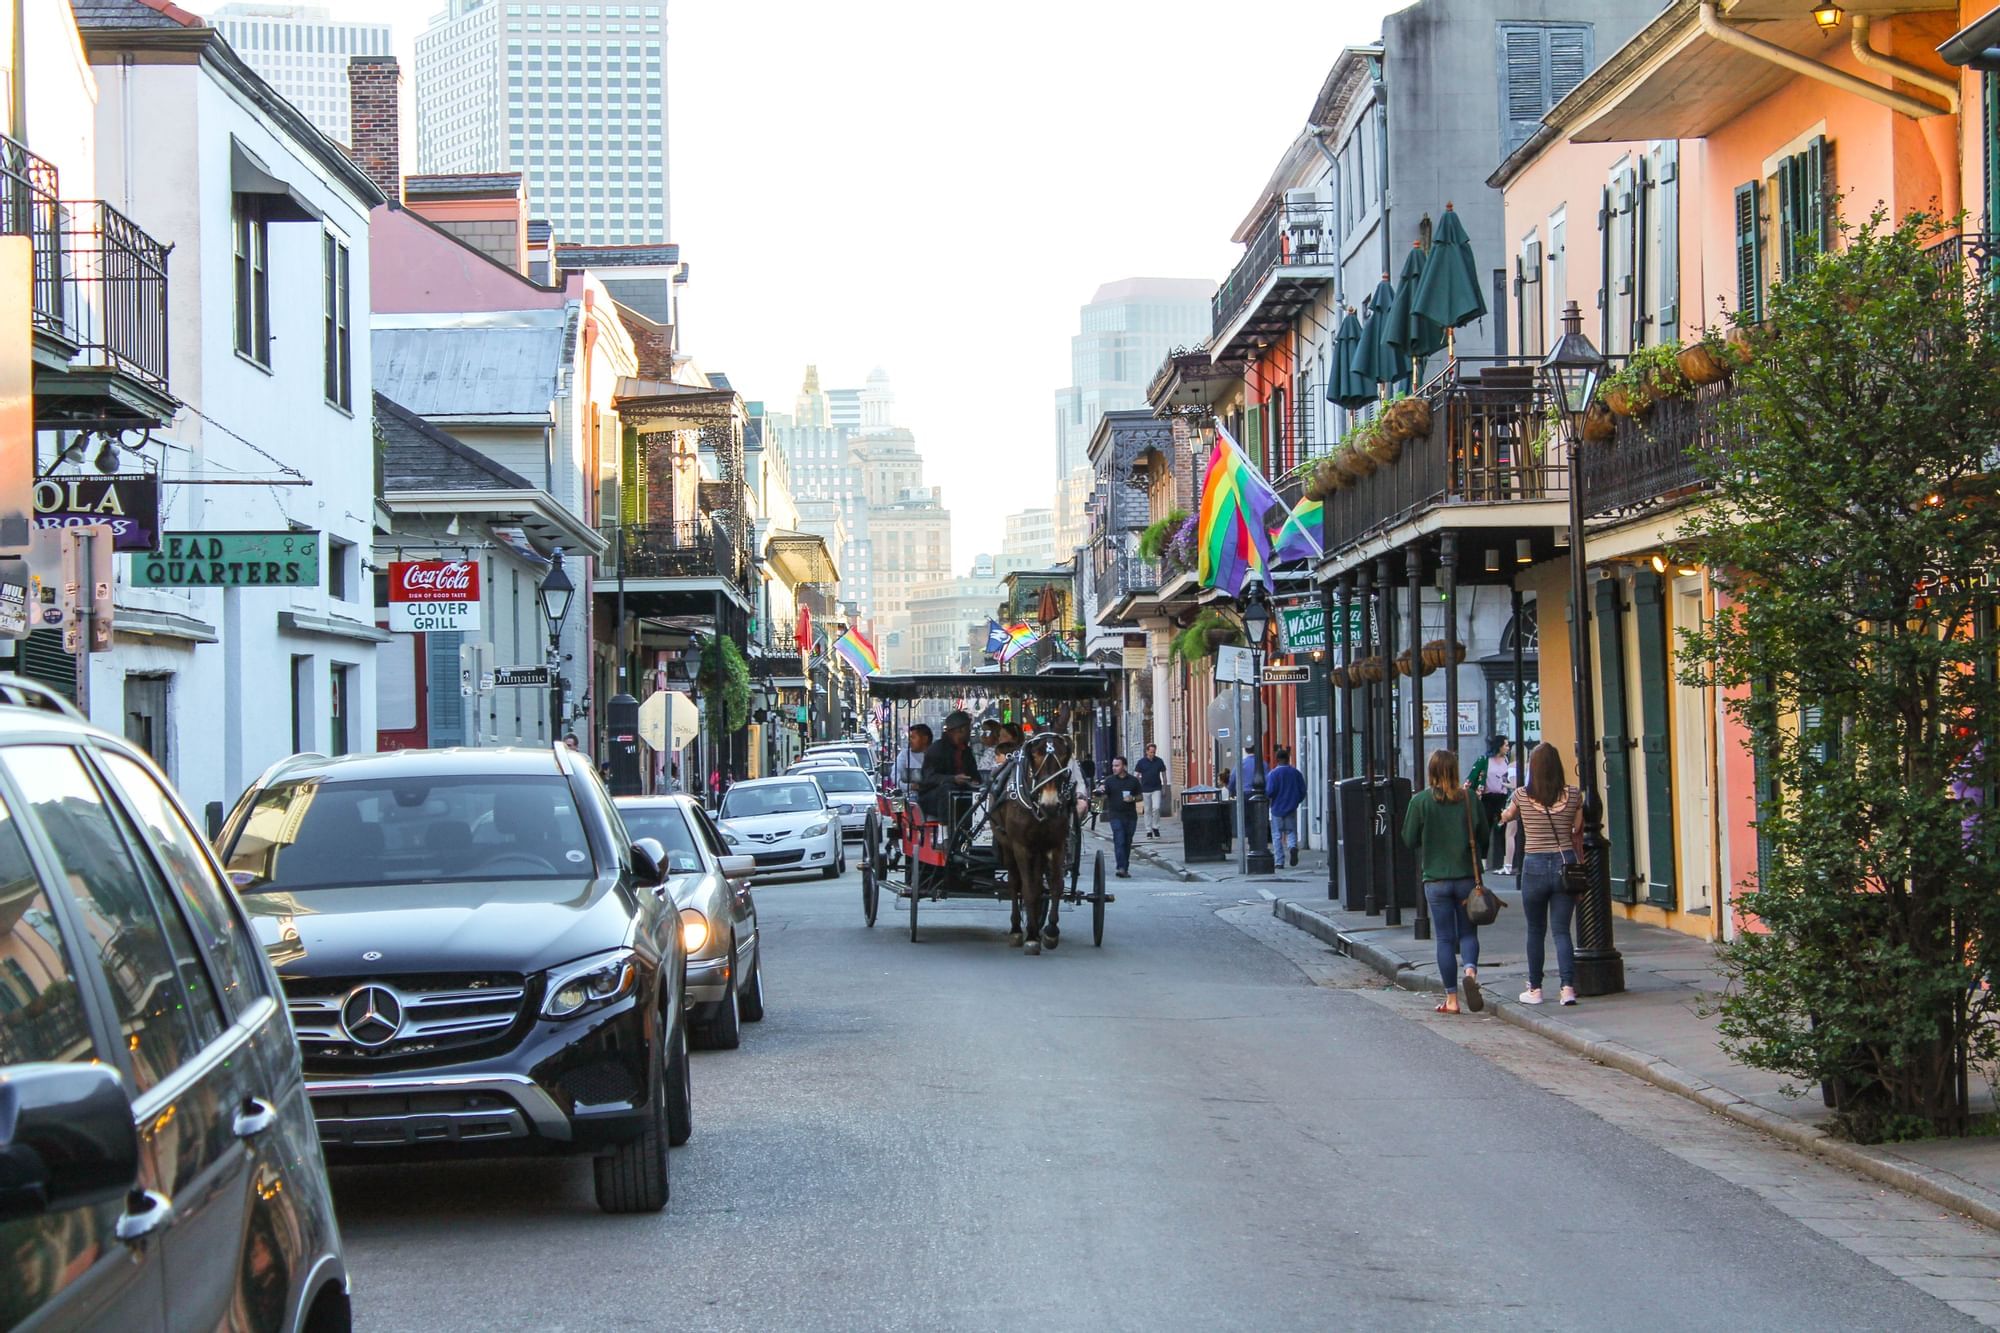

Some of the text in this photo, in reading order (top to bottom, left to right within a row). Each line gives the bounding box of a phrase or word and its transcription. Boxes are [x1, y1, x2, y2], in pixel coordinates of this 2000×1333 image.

[146, 562, 300, 584] QUARTERS
[404, 564, 471, 590] Coca-Cola
[407, 603, 468, 616] CLOVER
[414, 617, 458, 630] GRILL
[1288, 612, 1340, 637] WASHIG
[494, 672, 545, 684] Dumaine
[1265, 671, 1308, 681] Dumaine
